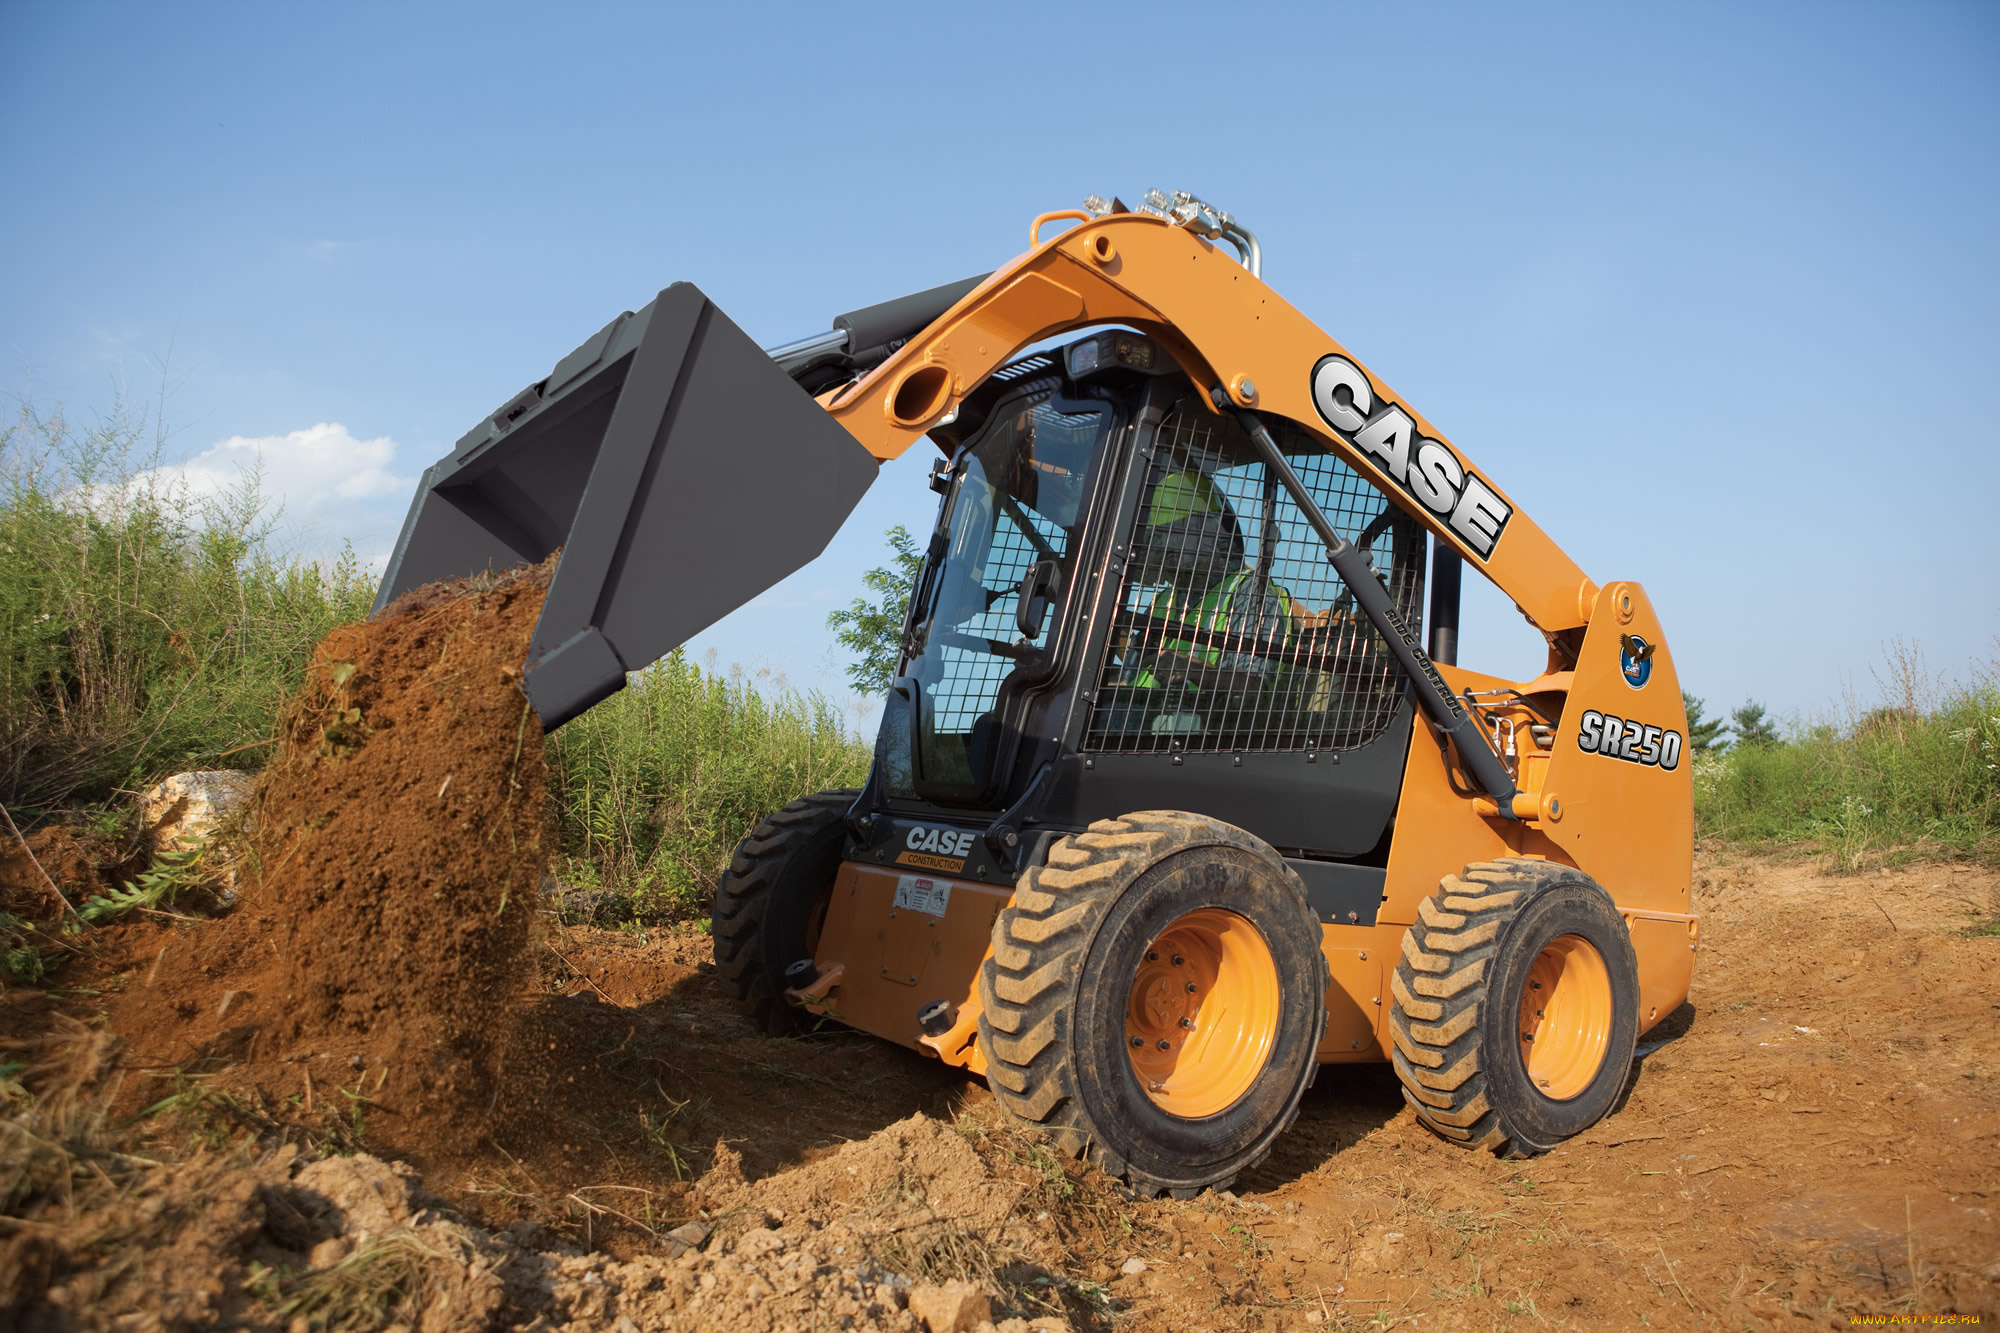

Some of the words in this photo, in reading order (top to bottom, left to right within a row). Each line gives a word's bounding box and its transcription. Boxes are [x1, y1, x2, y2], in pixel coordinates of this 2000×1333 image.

[1310, 353, 1513, 563] CASE
[1383, 608, 1415, 647] RIDE
[1411, 647, 1462, 719] CONTROL
[1578, 709, 1682, 771] SR250
[906, 826, 976, 857] CASE
[907, 854, 962, 870] CONSTRUCTION
[1115, 850, 1245, 917] GALAXY
